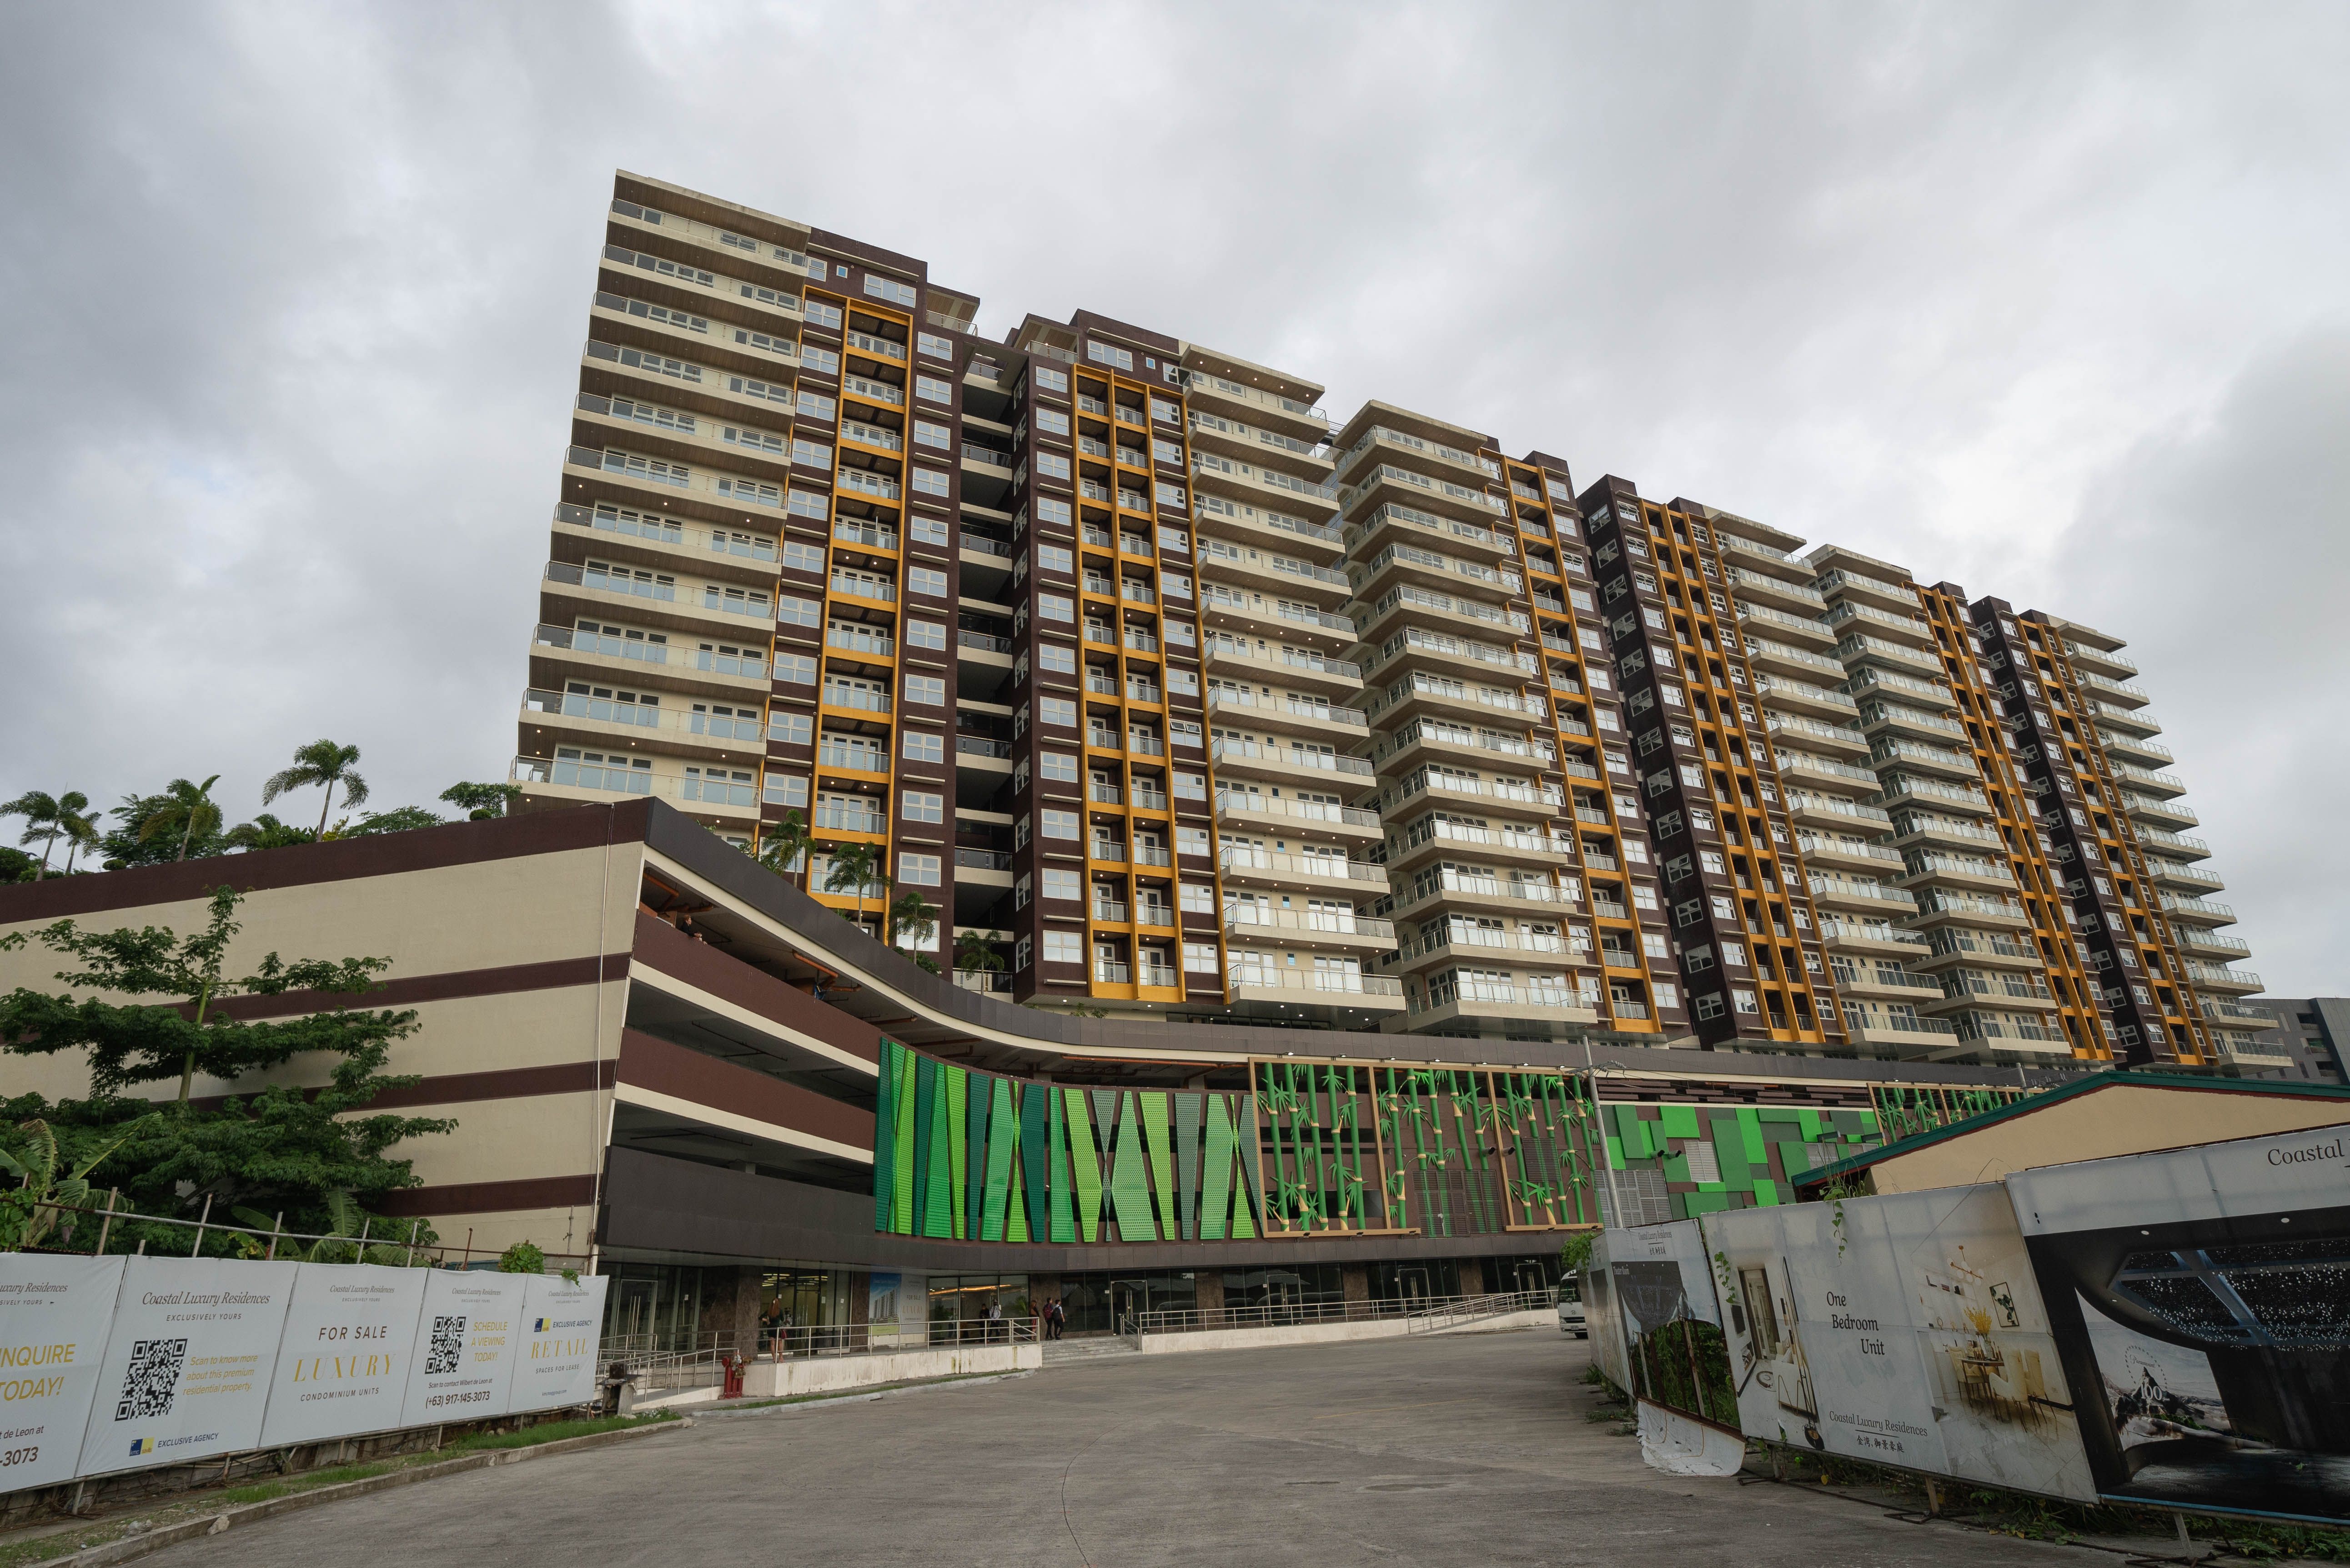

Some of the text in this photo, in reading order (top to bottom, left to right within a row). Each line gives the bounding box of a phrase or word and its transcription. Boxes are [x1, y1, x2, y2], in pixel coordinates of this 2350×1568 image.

[2268, 1139, 2345, 1166] Coastal
[25, 1282, 68, 1292] Residences
[330, 1285, 395, 1294] Coastal Luxury Residences
[142, 1292, 270, 1307] Coastal Luxury Residences
[1827, 1291, 1847, 1307] One
[166, 1313, 216, 1322] EXCLUSIVELY
[1831, 1313, 1879, 1331] Bedroom
[318, 1326, 387, 1341] FOR SALE
[473, 1321, 508, 1332] SCHEDULE
[471, 1337, 505, 1347] A VIEWING
[531, 1338, 588, 1359] RETAIL
[1860, 1338, 1885, 1355] Unit
[190, 1357, 208, 1366] Scan
[210, 1357, 218, 1365] to
[219, 1355, 239, 1364] know
[474, 1351, 498, 1362] TODAY!
[186, 1368, 254, 1381] about this premium
[291, 1353, 396, 1382] LUXURY
[183, 1382, 252, 1396] residential property.
[301, 1387, 379, 1402] CONDOMINIUM UNITS
[2140, 1383, 2162, 1401] 100
[426, 1391, 490, 1409] (+63) 917-145-3073
[1829, 1411, 1928, 1437] Coastal Luxury Residences
[4, 1430, 14, 1439] de
[15, 1427, 34, 1437] Leon
[36, 1425, 44, 1434] at
[158, 1433, 218, 1448] EXCLUSIVE AGENCY
